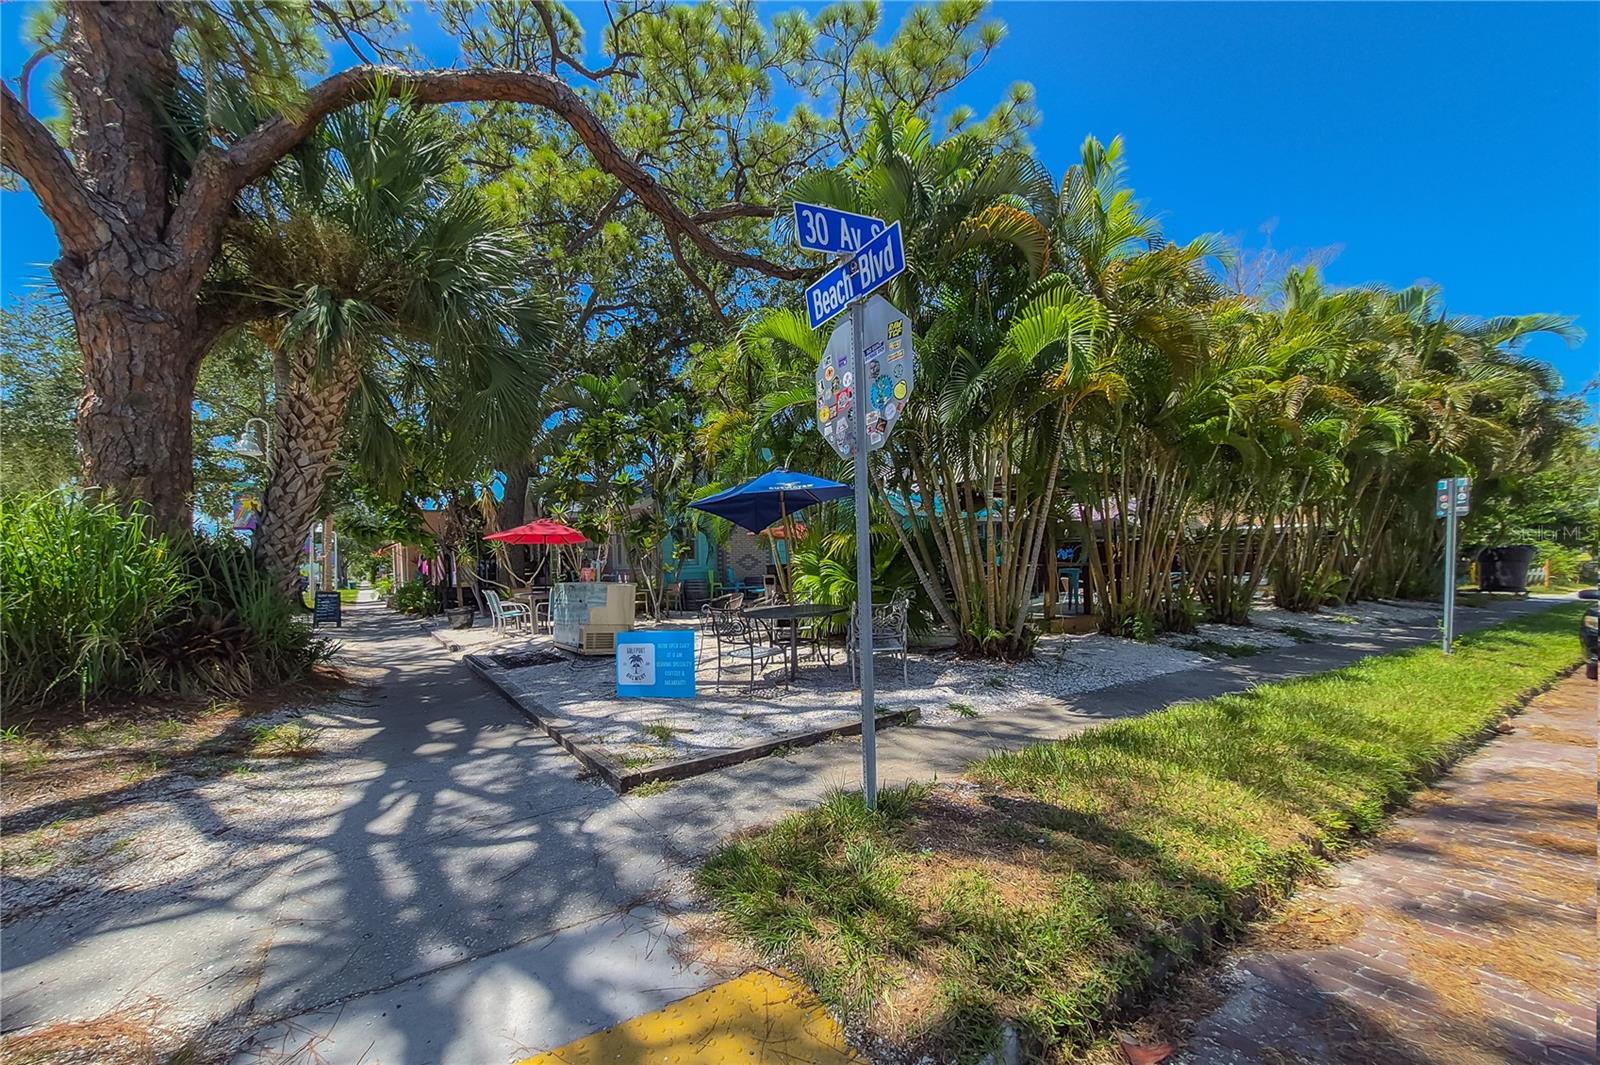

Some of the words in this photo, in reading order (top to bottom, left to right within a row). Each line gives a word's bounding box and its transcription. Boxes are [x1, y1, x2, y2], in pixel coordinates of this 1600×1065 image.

[802, 209, 829, 246] 30
[840, 217, 861, 250] Av
[812, 270, 854, 321] Beach
[858, 235, 895, 290] Blvd
